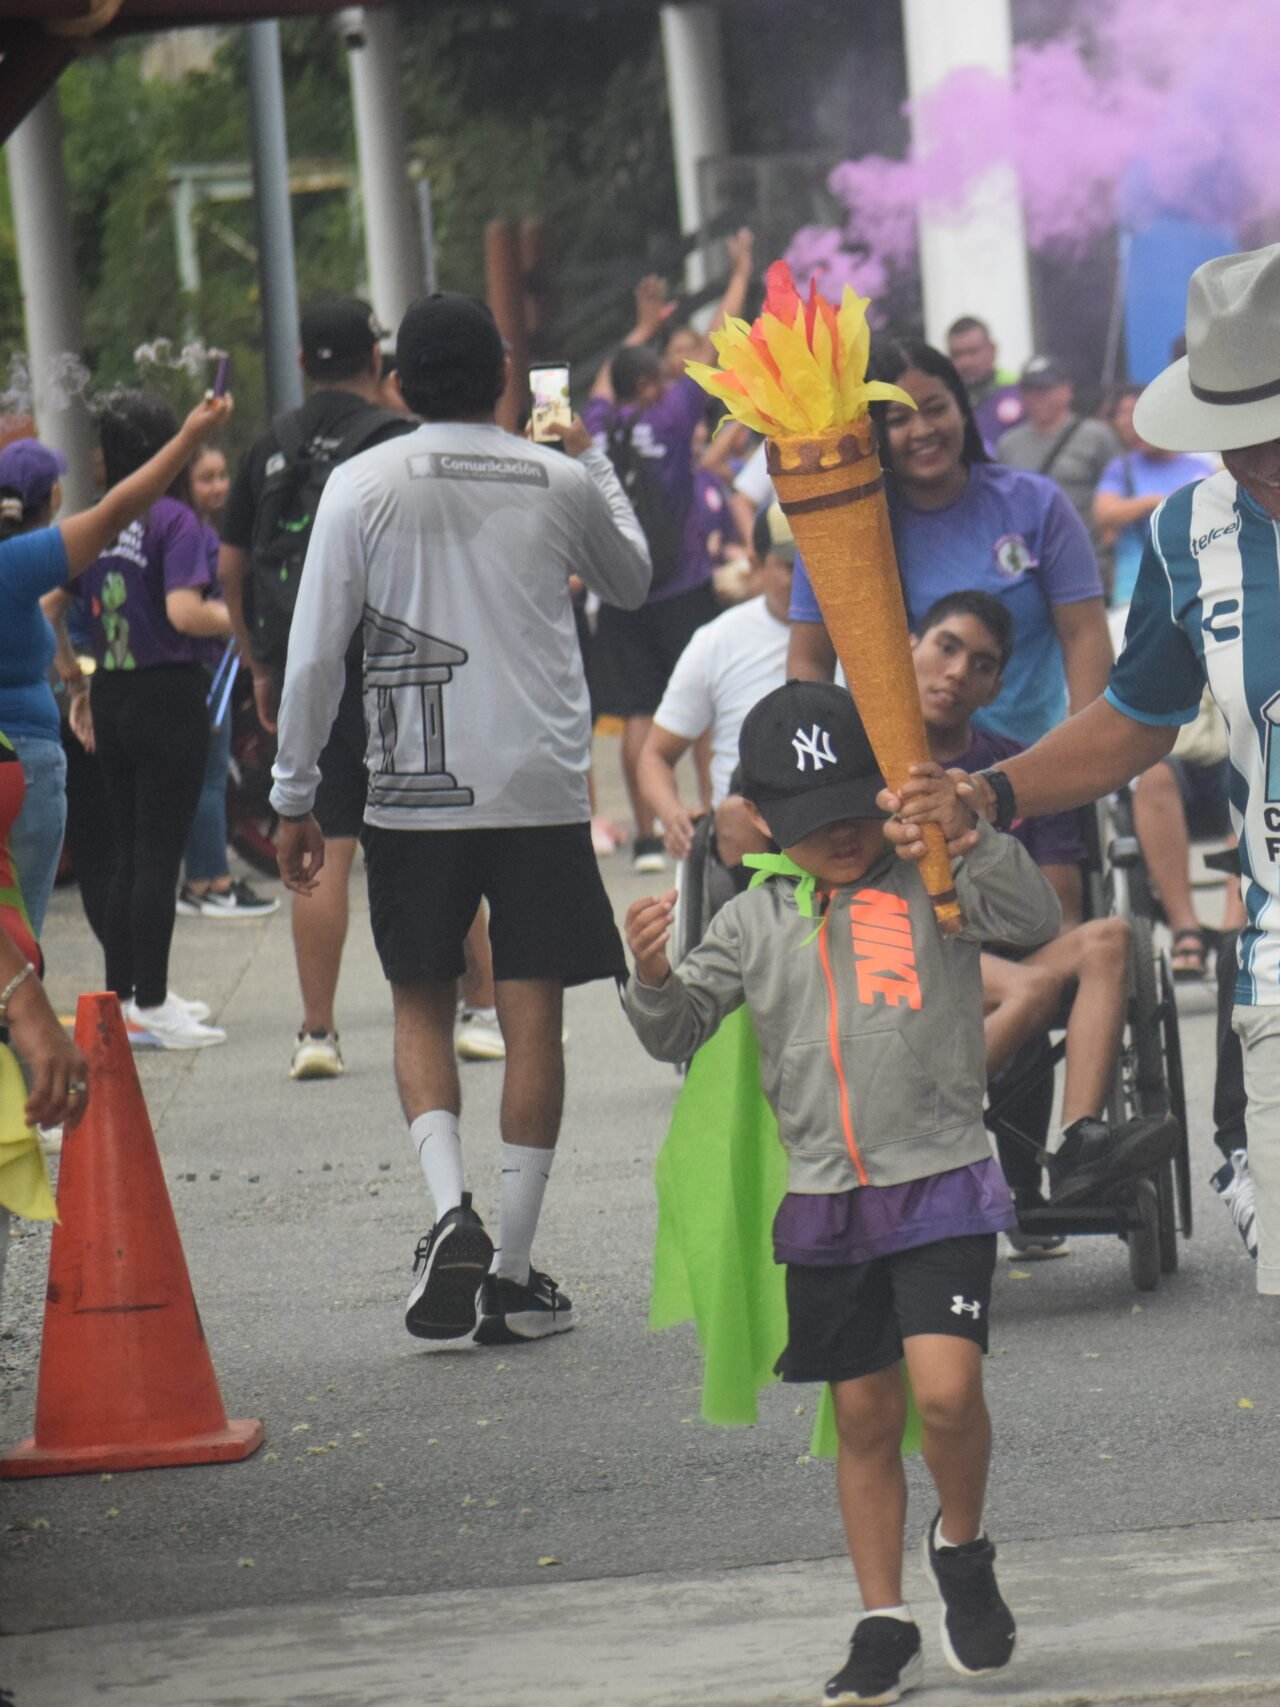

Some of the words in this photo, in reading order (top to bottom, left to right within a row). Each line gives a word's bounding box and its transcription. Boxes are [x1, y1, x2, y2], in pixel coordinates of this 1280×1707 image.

[440, 456, 542, 478] Comunicación
[1192, 514, 1240, 556] telcel
[850, 888, 922, 1010] NIKE
